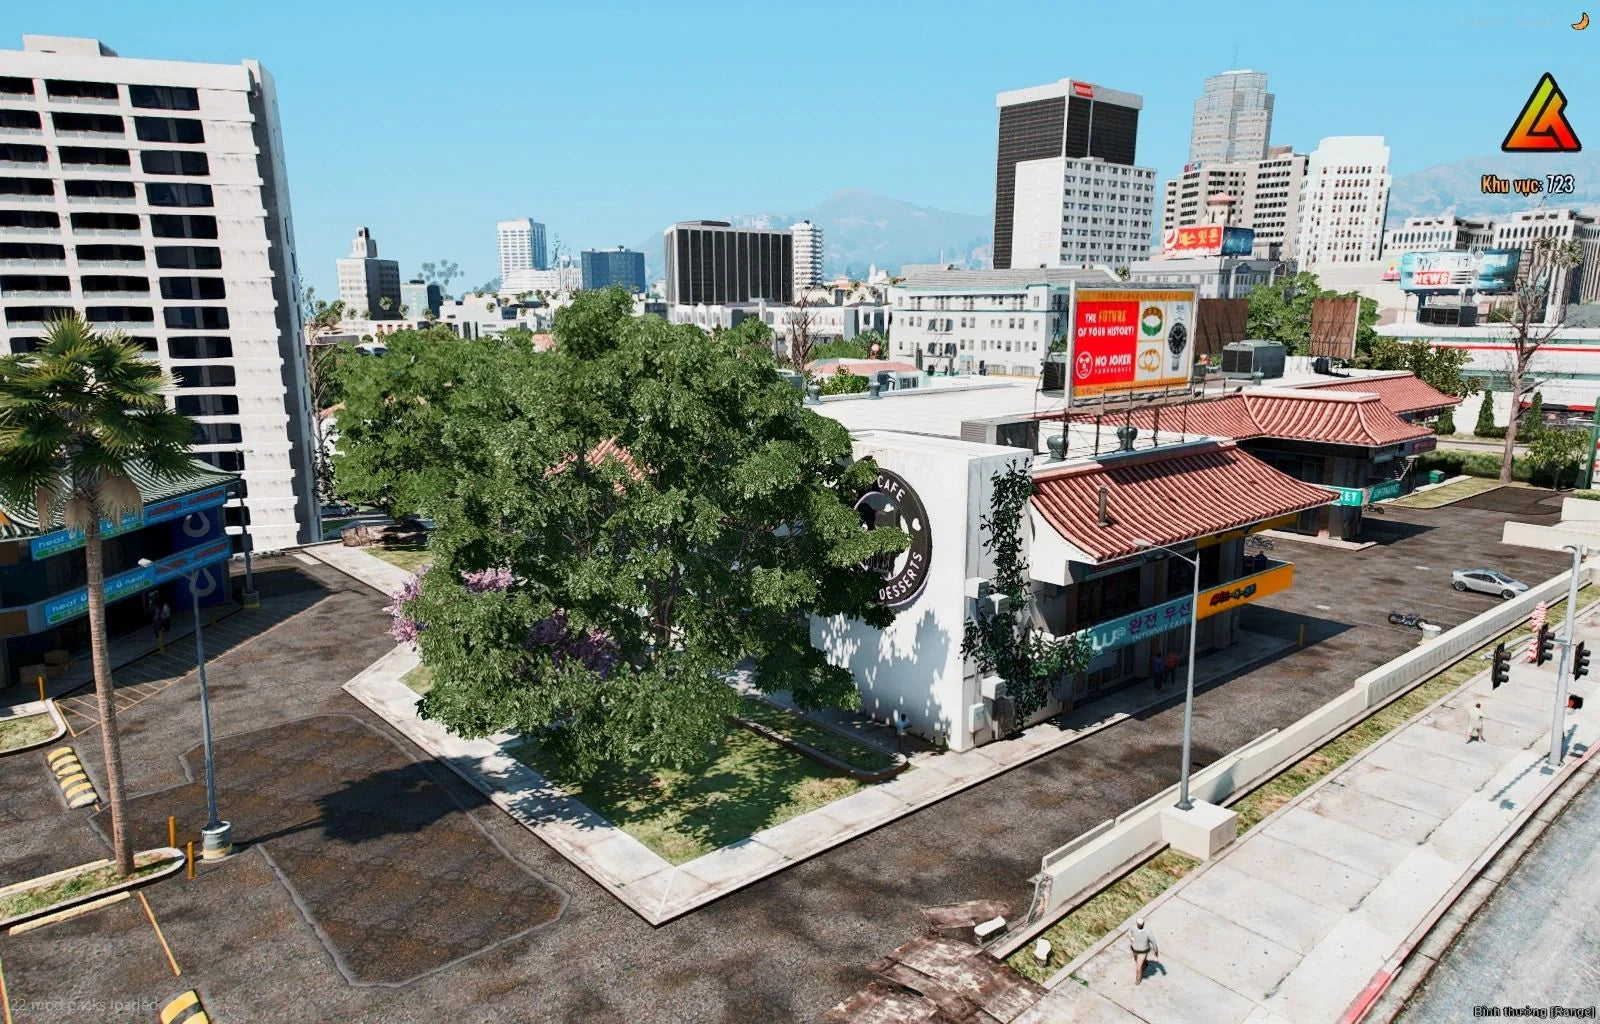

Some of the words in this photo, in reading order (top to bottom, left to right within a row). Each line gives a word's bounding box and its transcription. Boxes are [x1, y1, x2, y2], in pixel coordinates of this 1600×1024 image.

[1416, 272, 1448, 285] NEWS
[1085, 312, 1097, 323] THE
[1099, 309, 1127, 322] FUTURE
[1078, 327, 1087, 337] OF
[1089, 326, 1106, 337] YOUR
[1095, 355, 1107, 367] NO
[1109, 353, 1132, 366] JOKER
[877, 475, 906, 502] CAFE
[124, 573, 147, 586] heat
[878, 551, 923, 601] DESSERTS
[52, 598, 77, 612] heat
[1132, 624, 1168, 642] INTERNET
